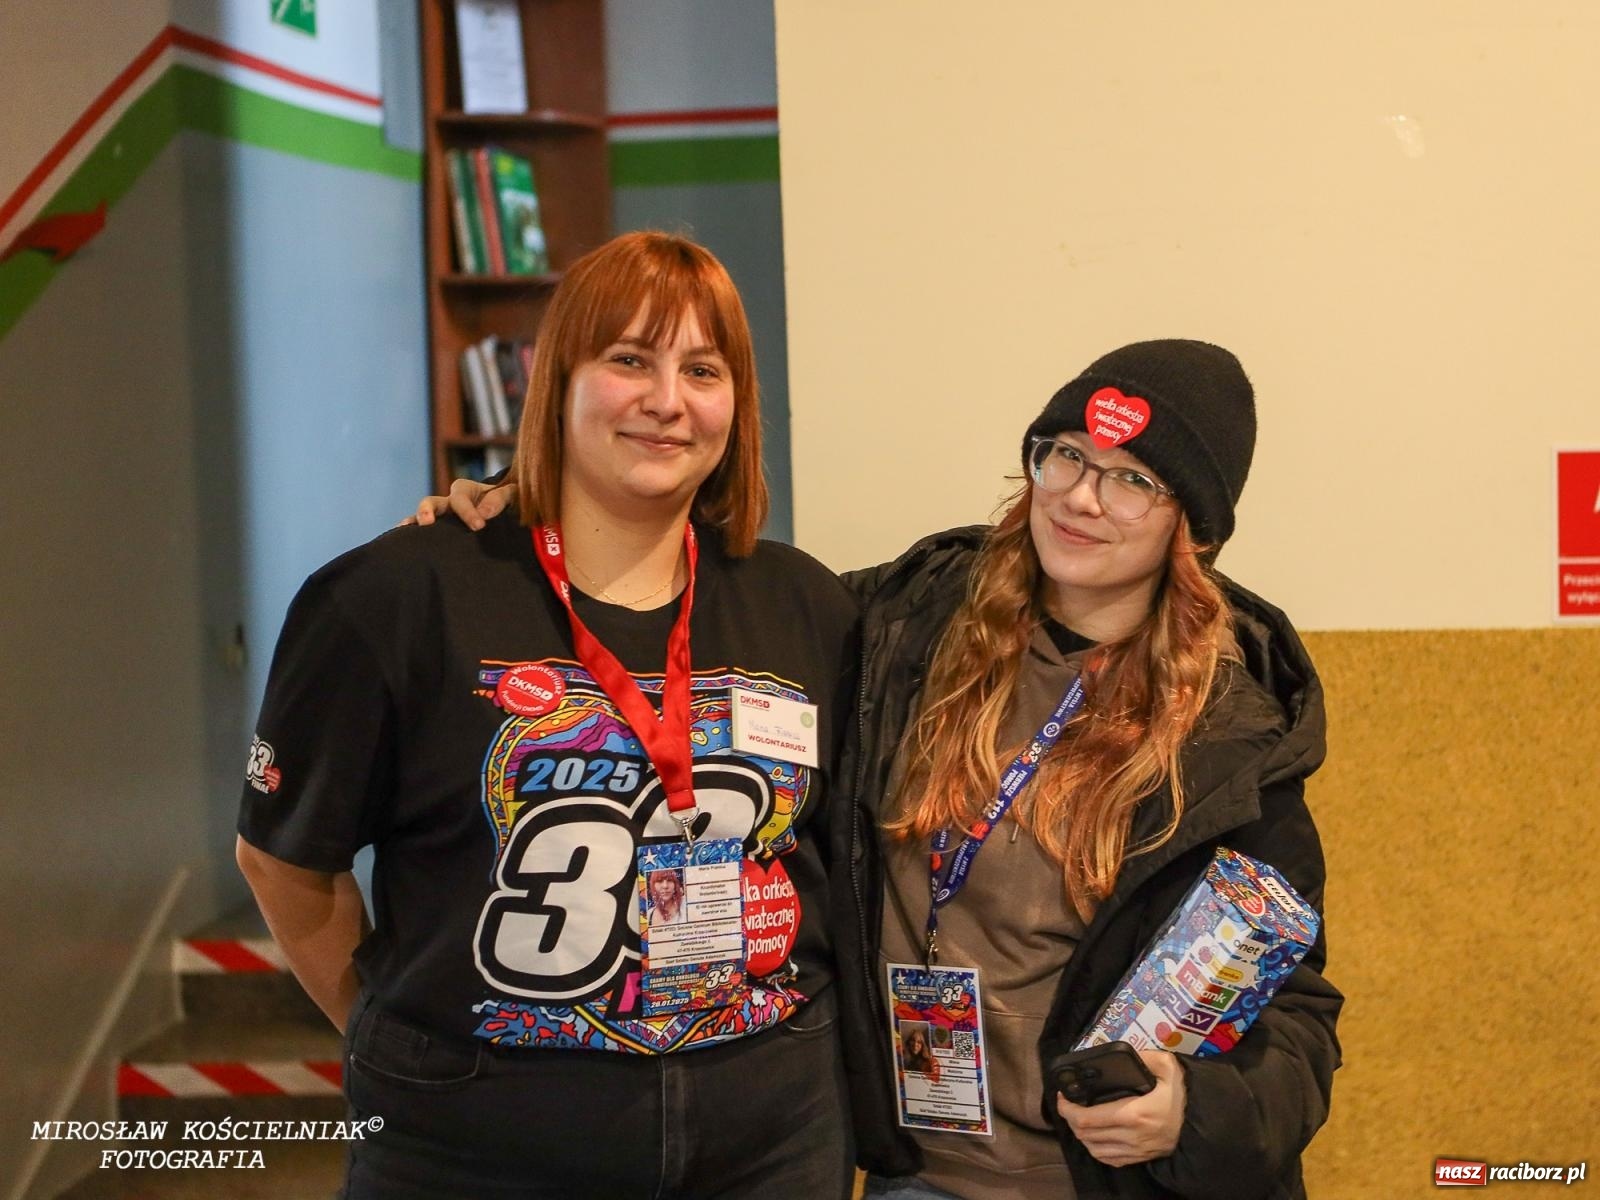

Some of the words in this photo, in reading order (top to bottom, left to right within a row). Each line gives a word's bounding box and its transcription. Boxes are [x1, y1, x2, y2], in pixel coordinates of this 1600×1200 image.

[748, 733, 807, 752] WOLONTARIUSZ
[521, 757, 640, 793] 2025
[747, 934, 788, 961] pomocy
[1234, 939, 1260, 955] onet
[705, 963, 735, 989] 33
[1183, 969, 1227, 1004] mBank
[942, 985, 964, 1004] 33
